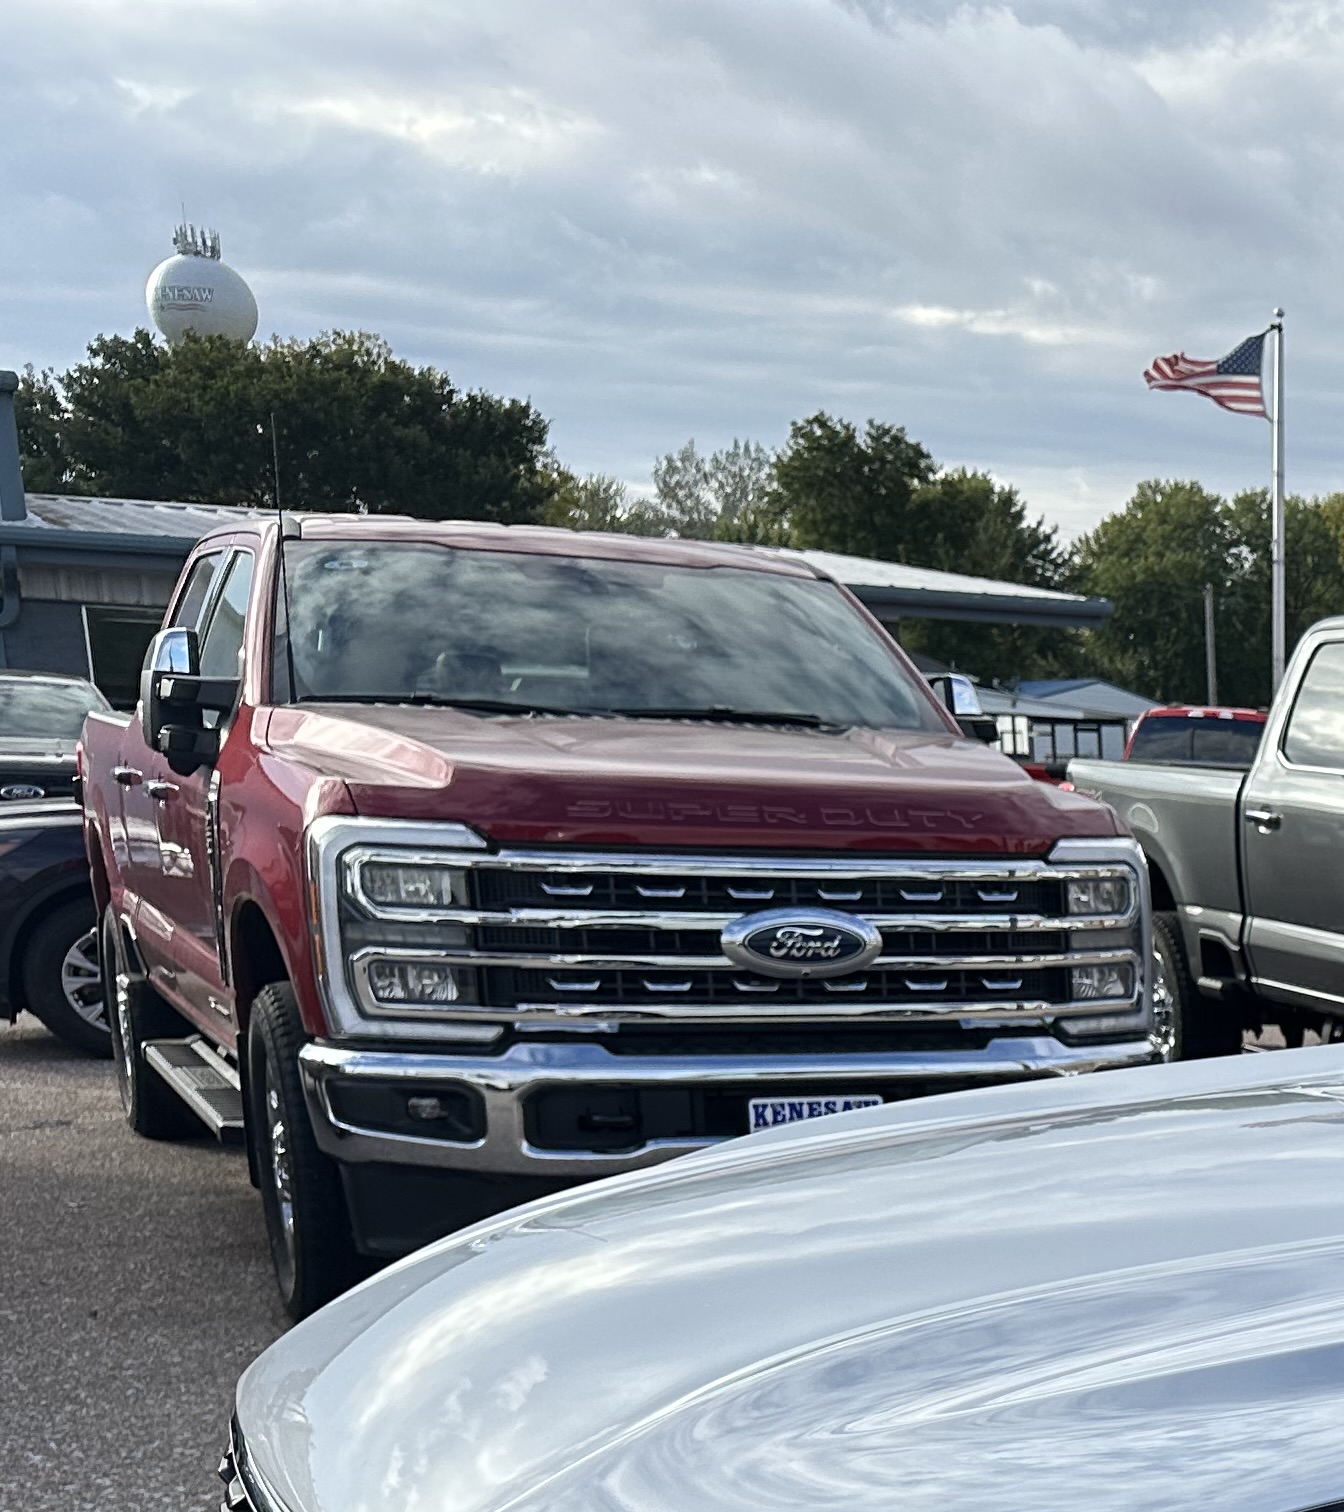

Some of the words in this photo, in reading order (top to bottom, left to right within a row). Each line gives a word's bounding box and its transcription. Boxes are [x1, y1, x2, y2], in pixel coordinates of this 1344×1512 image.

[566, 799, 807, 824] SUPER
[820, 808, 983, 828] DUTY
[769, 926, 842, 958] Ford
[752, 1100, 879, 1129] KENES
